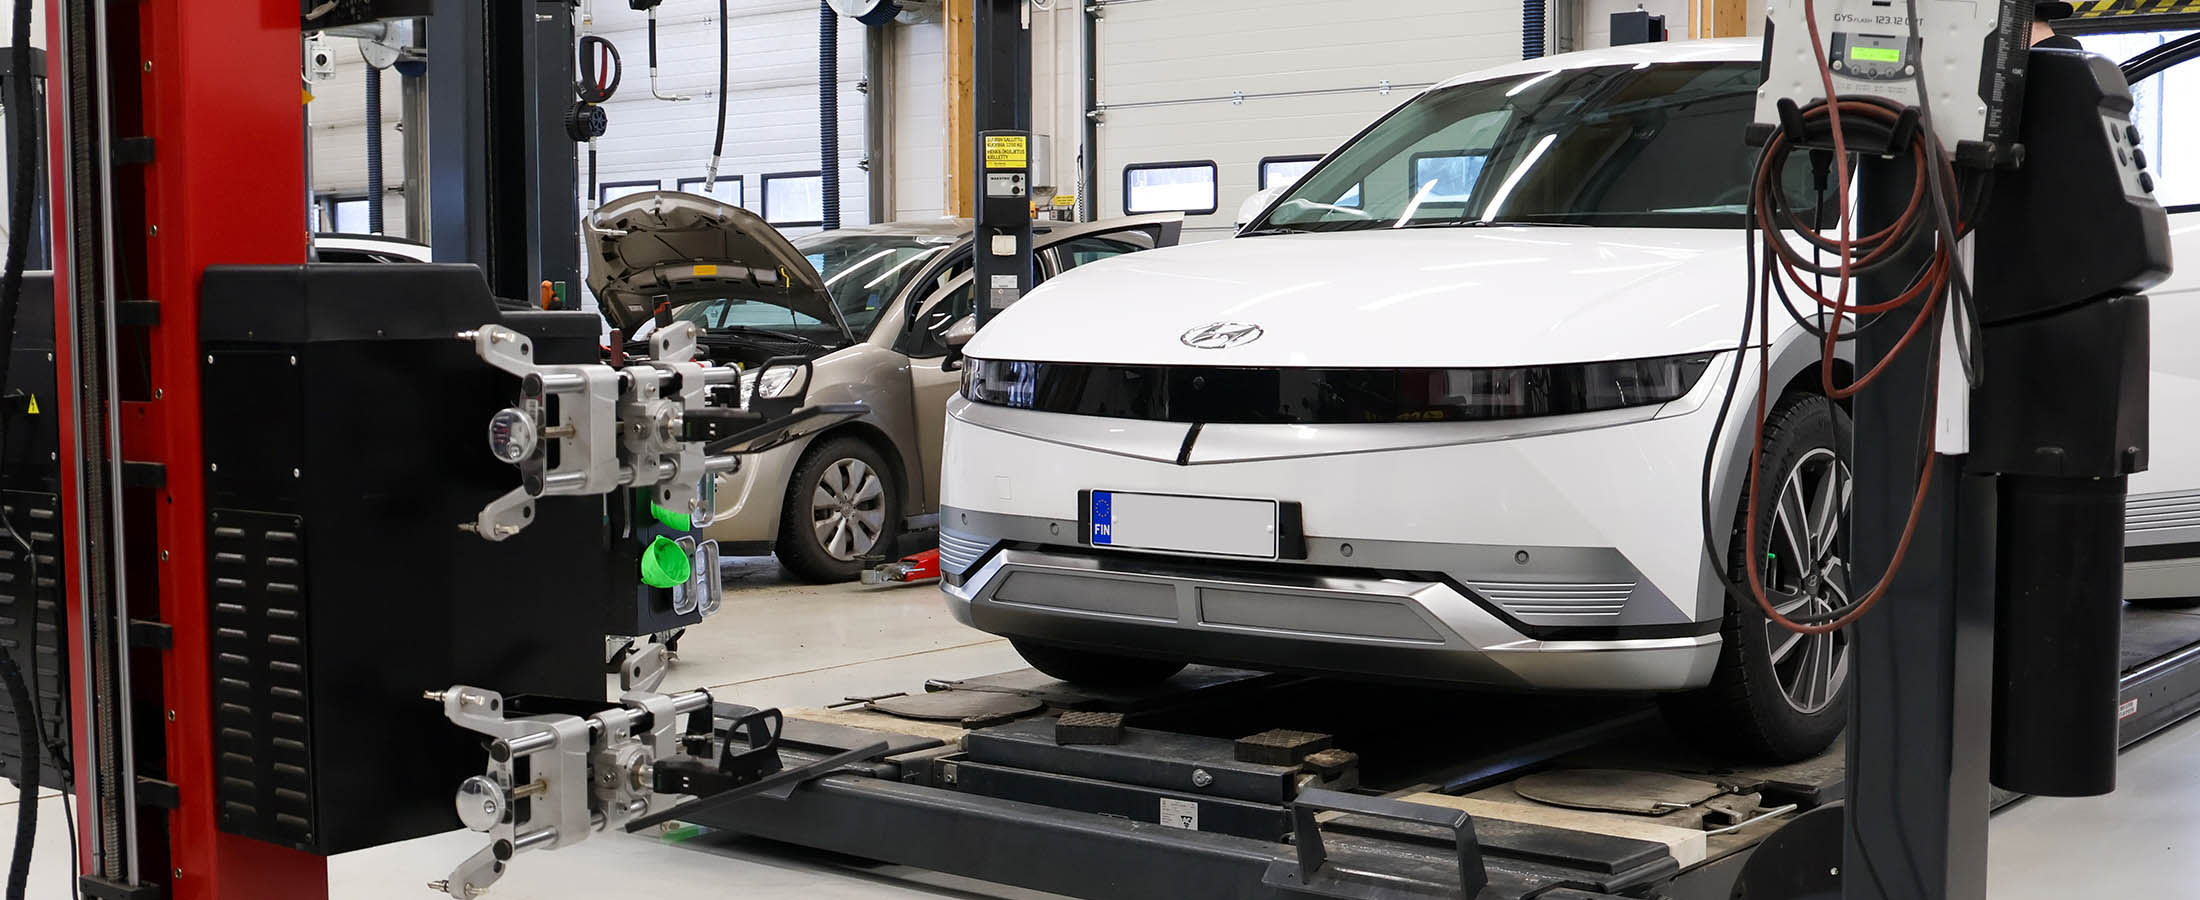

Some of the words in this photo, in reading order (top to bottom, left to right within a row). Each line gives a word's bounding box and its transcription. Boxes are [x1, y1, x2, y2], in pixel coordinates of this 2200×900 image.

[1875, 15, 1903, 25] 123.12
[1904, 17, 1924, 26] CT
[1094, 523, 1110, 536] FIN
